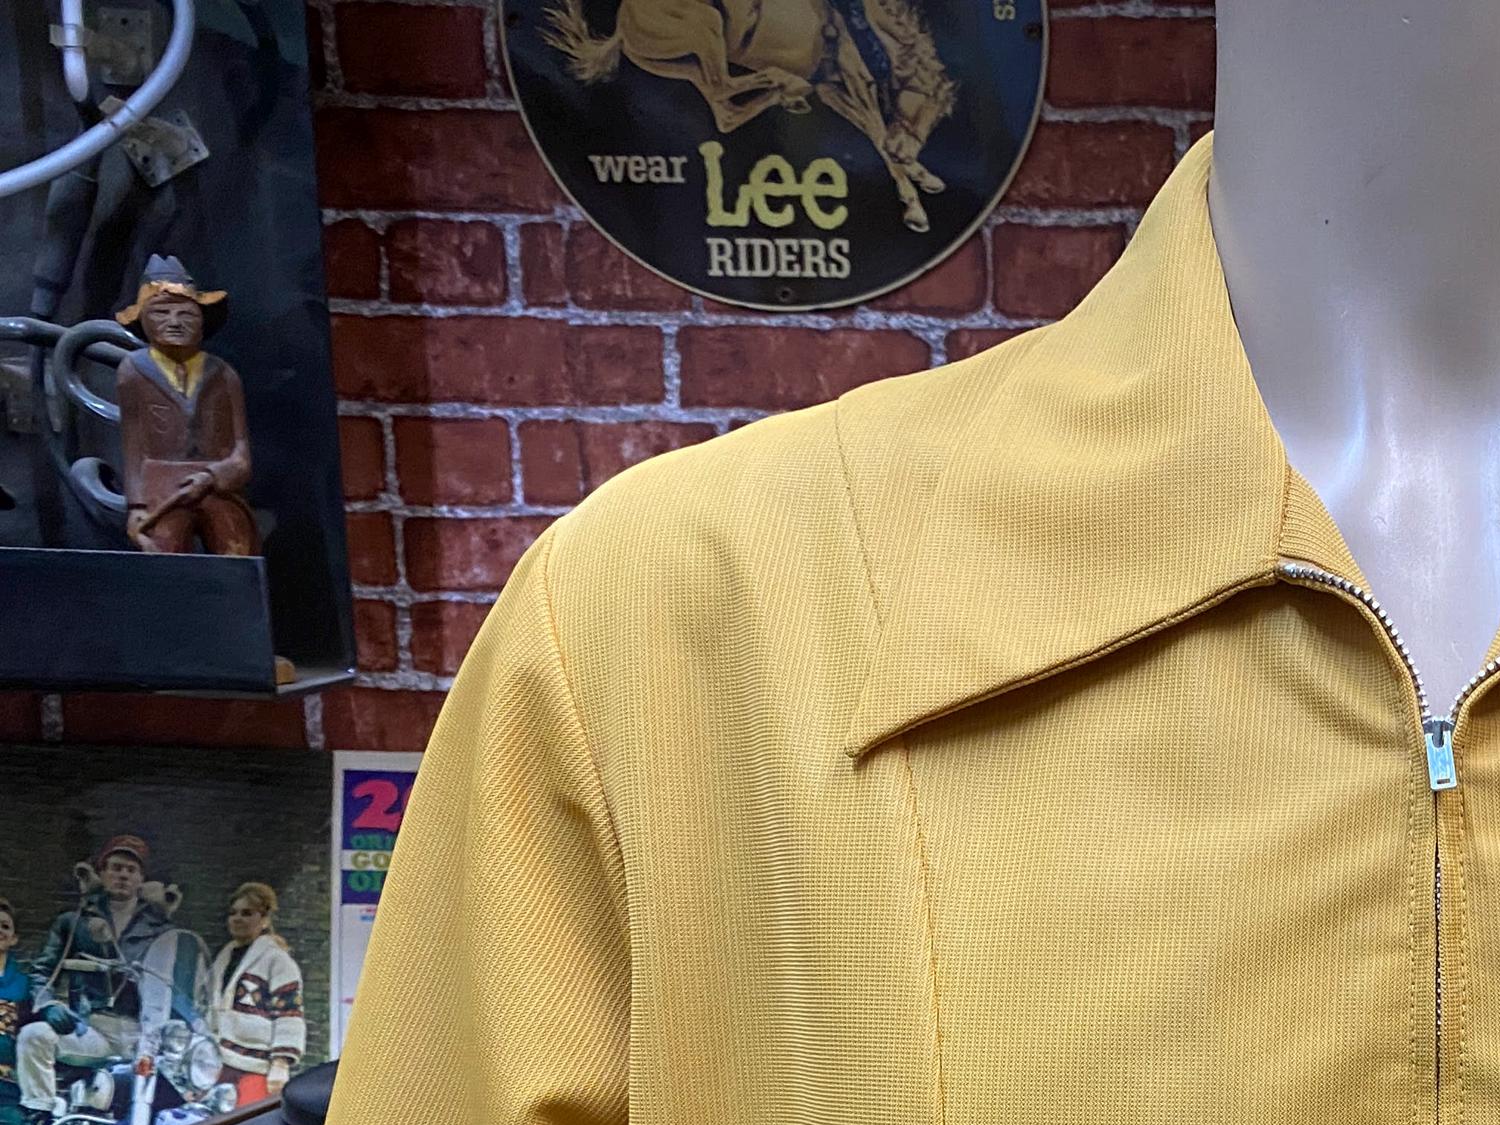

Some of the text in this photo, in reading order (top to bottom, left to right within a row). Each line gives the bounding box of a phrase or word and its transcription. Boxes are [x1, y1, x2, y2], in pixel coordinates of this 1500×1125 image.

[589, 141, 848, 231] wear Lee
[708, 239, 851, 279] RIDERS
